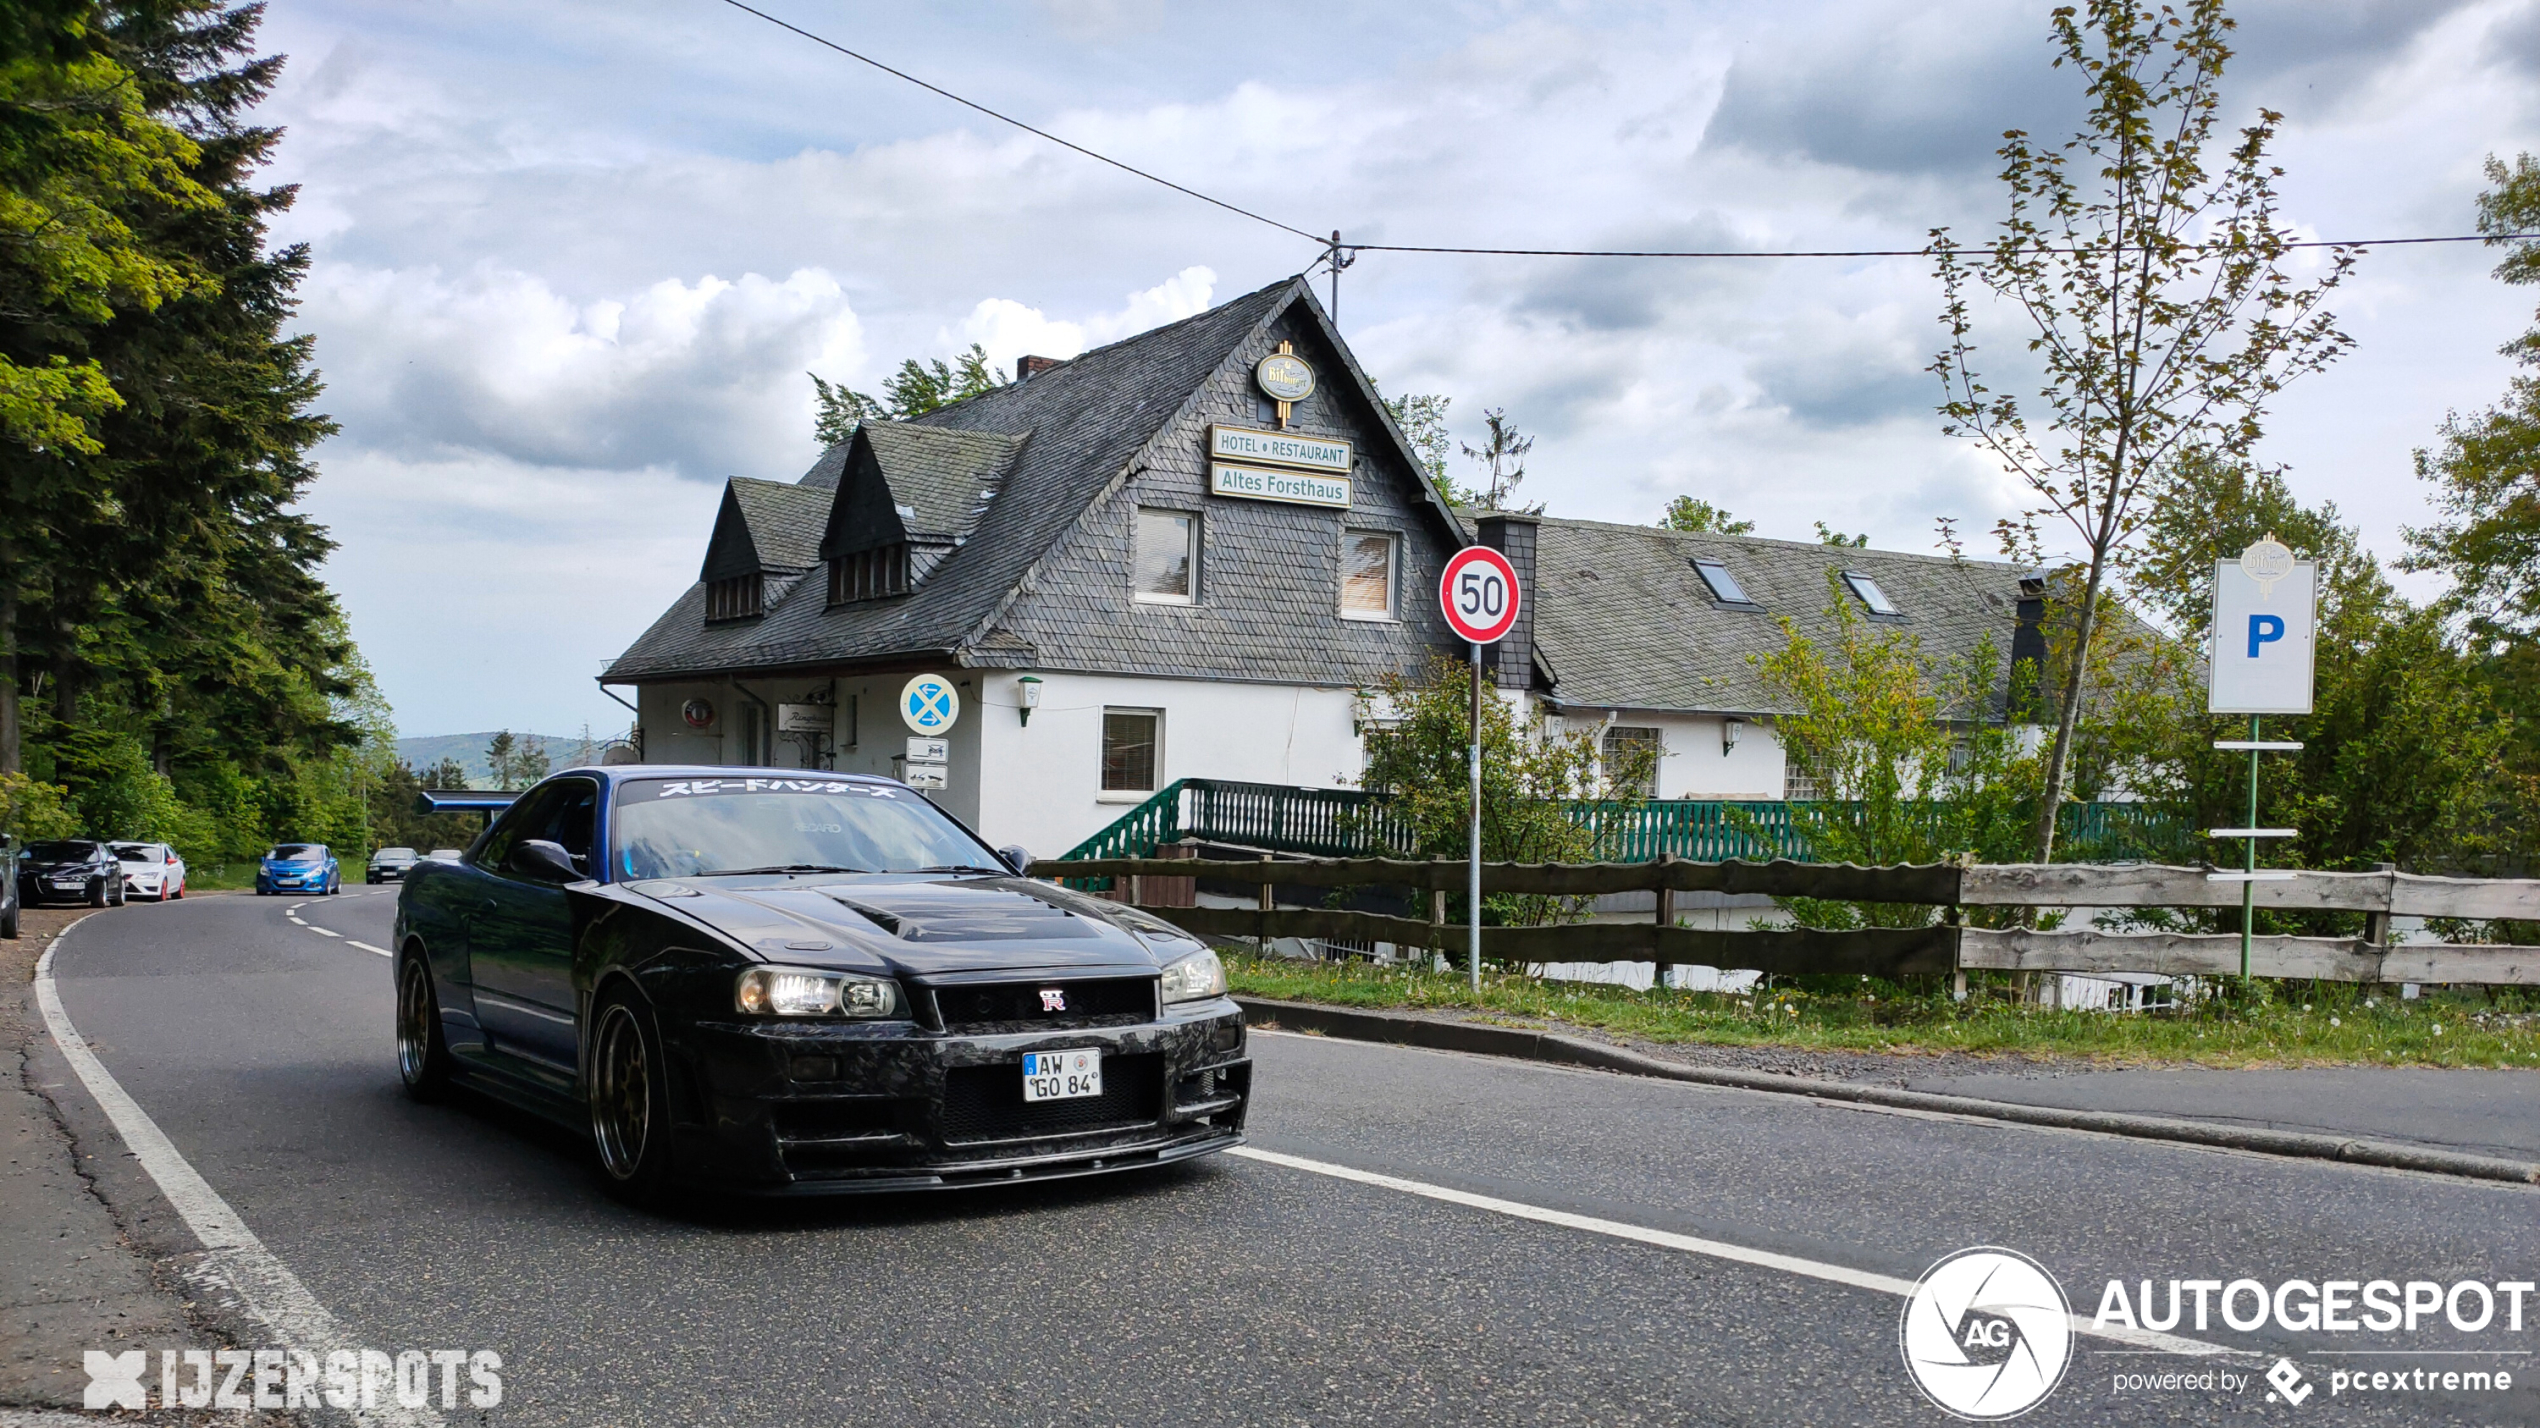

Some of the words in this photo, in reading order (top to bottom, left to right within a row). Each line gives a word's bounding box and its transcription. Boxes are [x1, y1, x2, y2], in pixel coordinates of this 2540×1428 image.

[1221, 434, 1258, 453] HOTEL
[1272, 441, 1344, 463] RESTAURANT
[1222, 470, 1262, 491] Altes
[1267, 476, 1343, 499] Forsthaus
[1461, 573, 1503, 617] 50
[2247, 614, 2285, 658] P
[659, 778, 897, 799] スピードハンターズ
[794, 822, 842, 834] RECARO
[1039, 1055, 1063, 1075] AW
[1035, 1077, 1060, 1097] GO
[1068, 1075, 1090, 1094] 84
